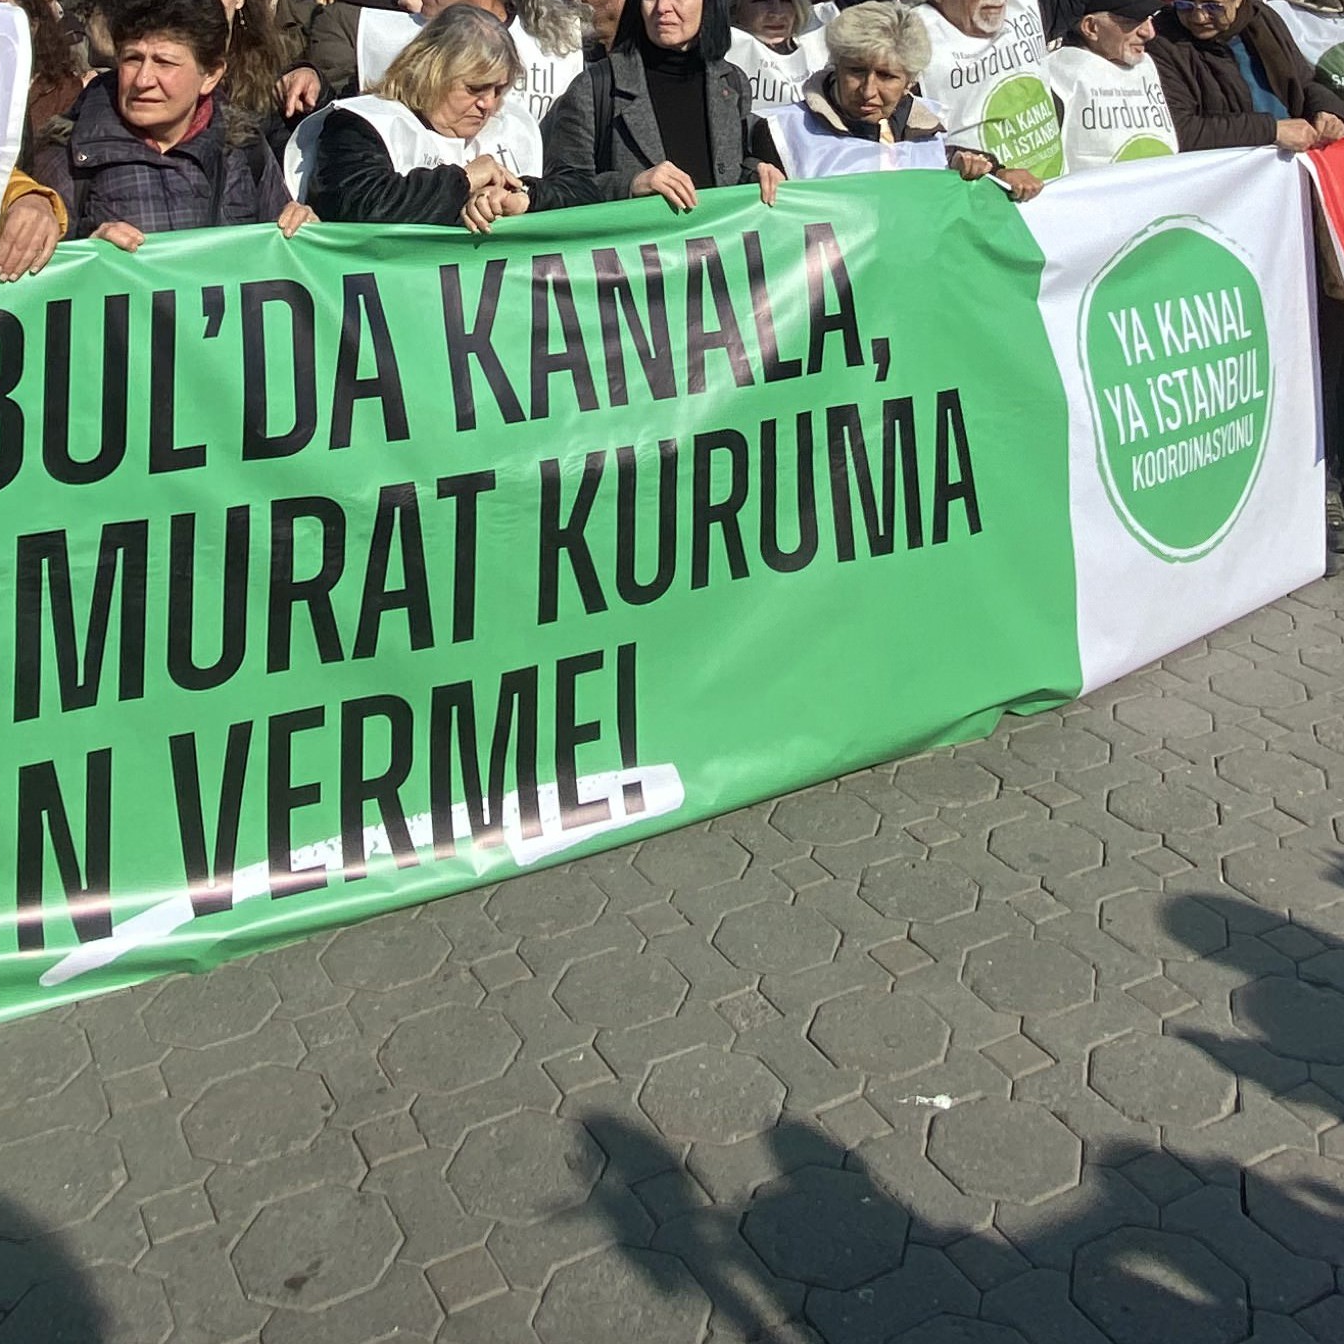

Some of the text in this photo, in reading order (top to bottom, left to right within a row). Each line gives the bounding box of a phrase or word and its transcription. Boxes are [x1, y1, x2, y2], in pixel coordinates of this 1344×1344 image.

[990, 143, 1014, 165] YA
[993, 99, 1052, 140] YA KANAL
[439, 221, 891, 432] KANALA,
[1108, 286, 1253, 367] YA KANAL
[1103, 349, 1264, 446] YA İSTANBUL
[13, 468, 496, 722] MURAT
[538, 388, 982, 626] KURUMA
[169, 641, 647, 916] VERME!
